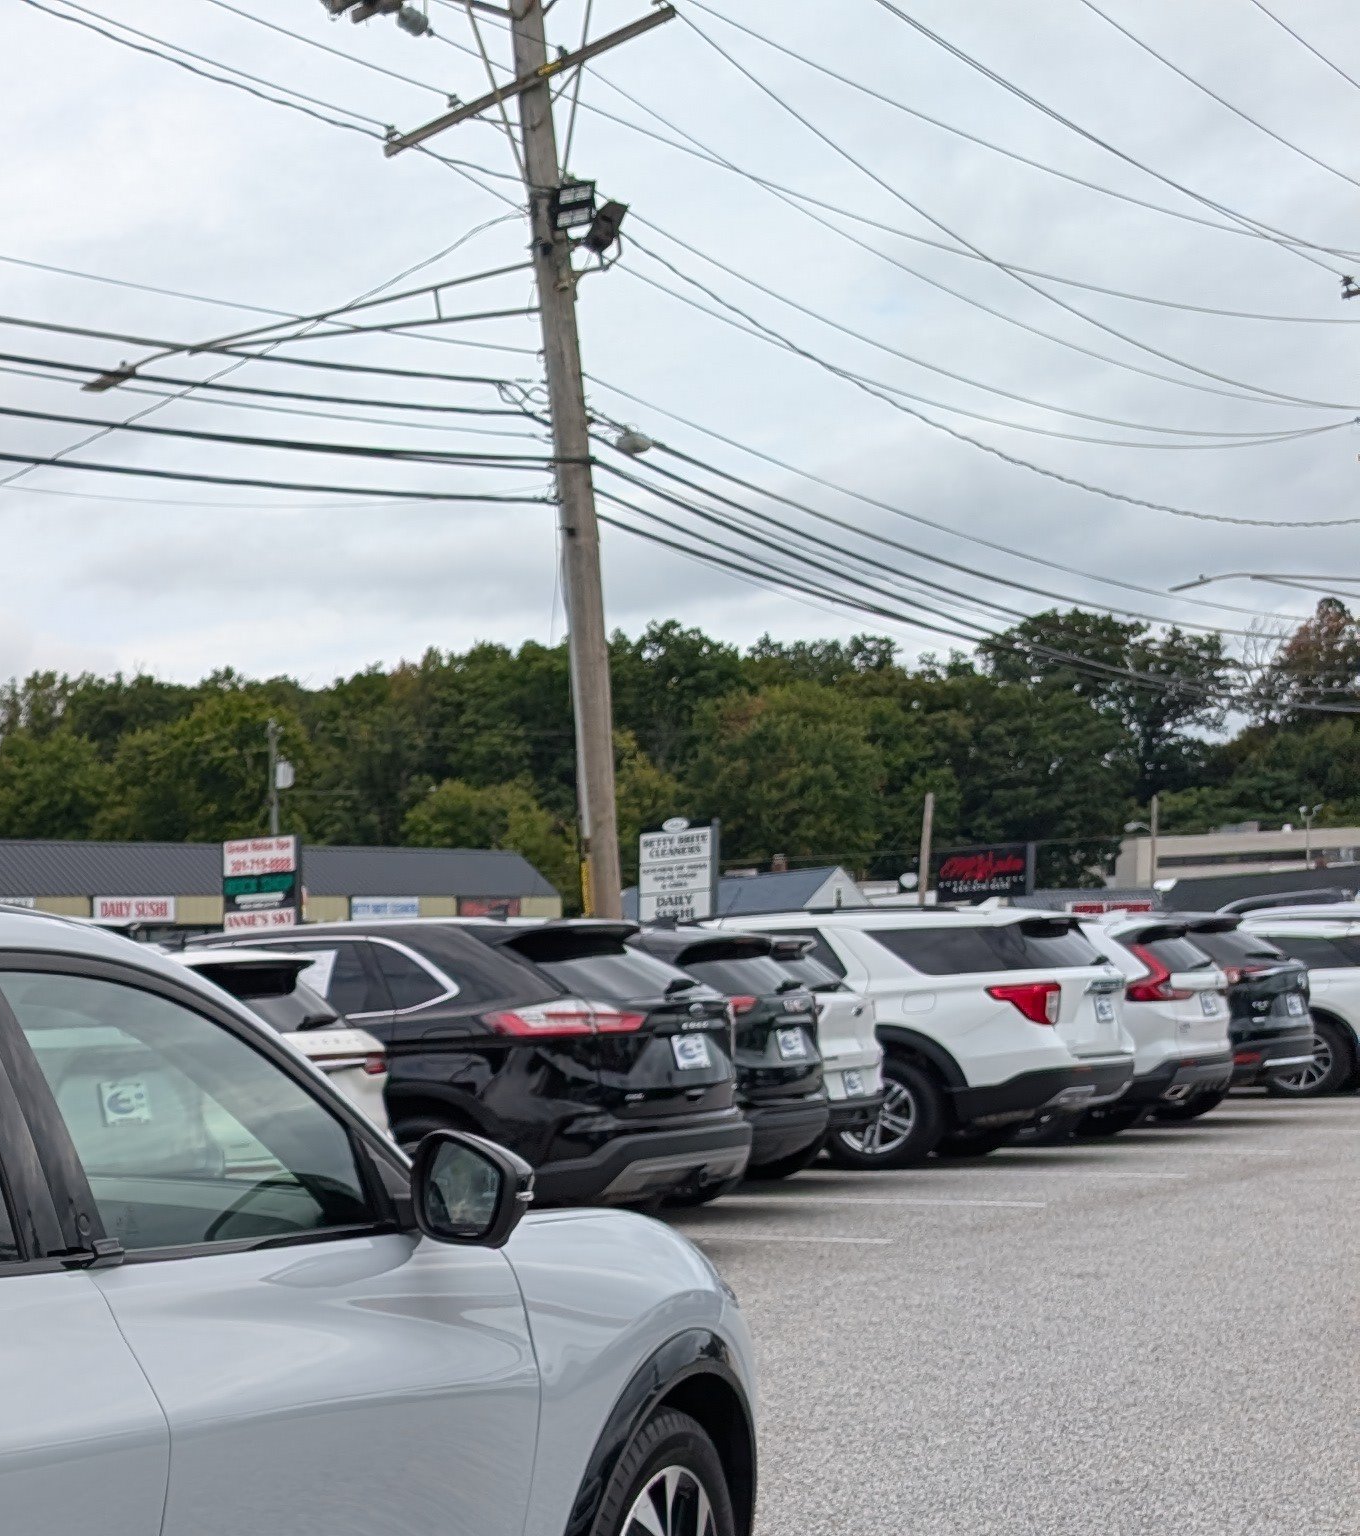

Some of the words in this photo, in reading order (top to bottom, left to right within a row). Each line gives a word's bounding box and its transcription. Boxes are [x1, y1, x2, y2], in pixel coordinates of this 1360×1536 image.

[656, 894, 693, 908] DAILY
[100, 901, 131, 918] DAILY
[135, 901, 169, 917] SUSHI
